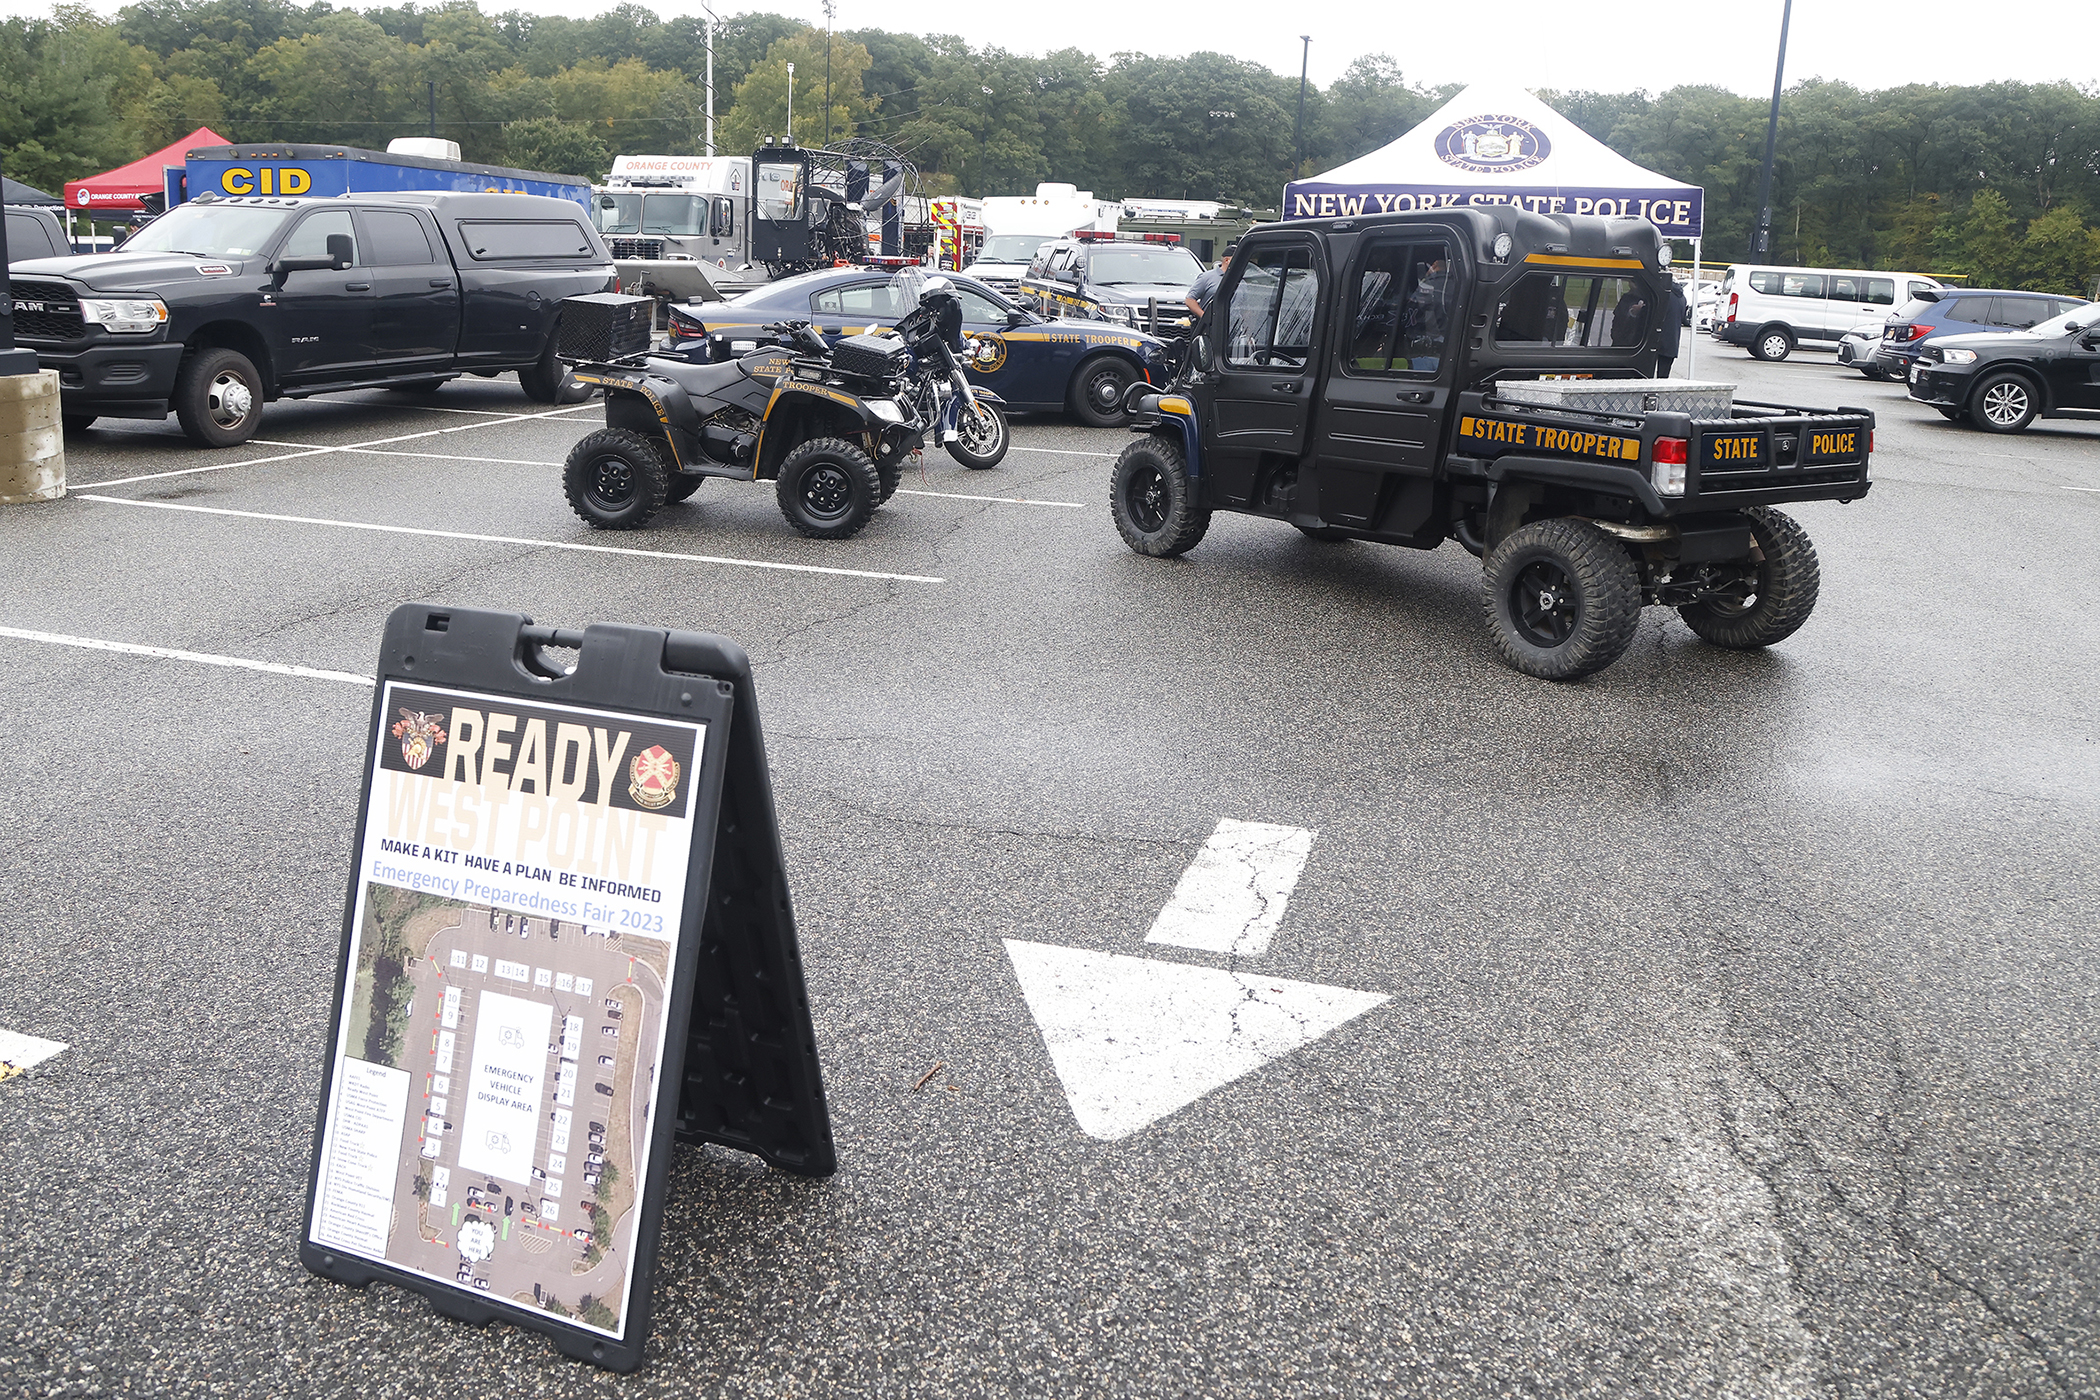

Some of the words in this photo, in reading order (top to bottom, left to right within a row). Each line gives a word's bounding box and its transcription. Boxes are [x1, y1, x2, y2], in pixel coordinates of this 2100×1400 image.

[1451, 114, 1485, 129] NEW
[1491, 114, 1537, 131] YORK
[626, 161, 667, 171] ORANGE
[670, 161, 713, 171] COUNTY
[1440, 154, 1484, 173] STATE
[1491, 156, 1544, 173] POLICE
[221, 167, 312, 195] CID
[1294, 193, 1369, 217] NEW
[1373, 193, 1456, 213] YORK
[1575, 197, 1690, 226] POLICE
[291, 336, 319, 344] RAM
[1051, 333, 1080, 344] STATE
[1085, 334, 1130, 346] TROOPER
[753, 365, 782, 373] STATE
[782, 380, 828, 396] TROOPER
[602, 376, 634, 389] STATE
[640, 385, 665, 417] POLICE
[1475, 419, 1527, 444] STATE
[1535, 426, 1622, 459] TROOPER
[1713, 437, 1759, 460] STATE
[1812, 433, 1856, 455] POLICE
[443, 706, 632, 806] READY
[386, 770, 510, 856] WEST
[515, 792, 668, 886] POINT
[381, 838, 420, 857] MAKE
[422, 846, 431, 860] A
[434, 848, 459, 864] KIT
[464, 854, 500, 873] HAVE
[502, 862, 512, 875] A
[515, 864, 552, 882] PLAN
[559, 872, 577, 887] BE
[581, 876, 661, 903] INFORMED
[373, 860, 459, 896] Emergency
[464, 878, 577, 916] Preparedness
[583, 901, 615, 923] Fair
[619, 909, 663, 933] 2023
[455, 955, 465, 964] 11
[475, 959, 485, 968] 12
[502, 965, 511, 974] 13
[515, 968, 524, 977] 14
[539, 973, 549, 983] 15
[561, 978, 572, 988] 16
[581, 983, 591, 992] 17
[448, 993, 458, 1003] 10
[448, 1011, 454, 1020] 9
[569, 1022, 579, 1032] 18
[444, 1038, 450, 1047] 8
[567, 1042, 577, 1052] 19
[442, 1055, 448, 1064] 7
[484, 1064, 534, 1084] EMERGENCY
[563, 1068, 574, 1079] 20
[438, 1080, 444, 1089] 6
[490, 1080, 522, 1096] VEHICLE
[561, 1088, 571, 1098] 21
[436, 1102, 441, 1111] 5
[477, 1091, 510, 1106] DISPLAY
[510, 1100, 533, 1113] AREA
[557, 1114, 568, 1125] 22
[555, 1134, 566, 1145] 23
[431, 1142, 436, 1152] 3
[552, 1159, 562, 1168] 24
[439, 1172, 445, 1181] 2
[548, 1181, 559, 1192] 25
[545, 1204, 555, 1215] 26
[472, 1228, 484, 1236] YOU
[470, 1237, 481, 1245] ARE
